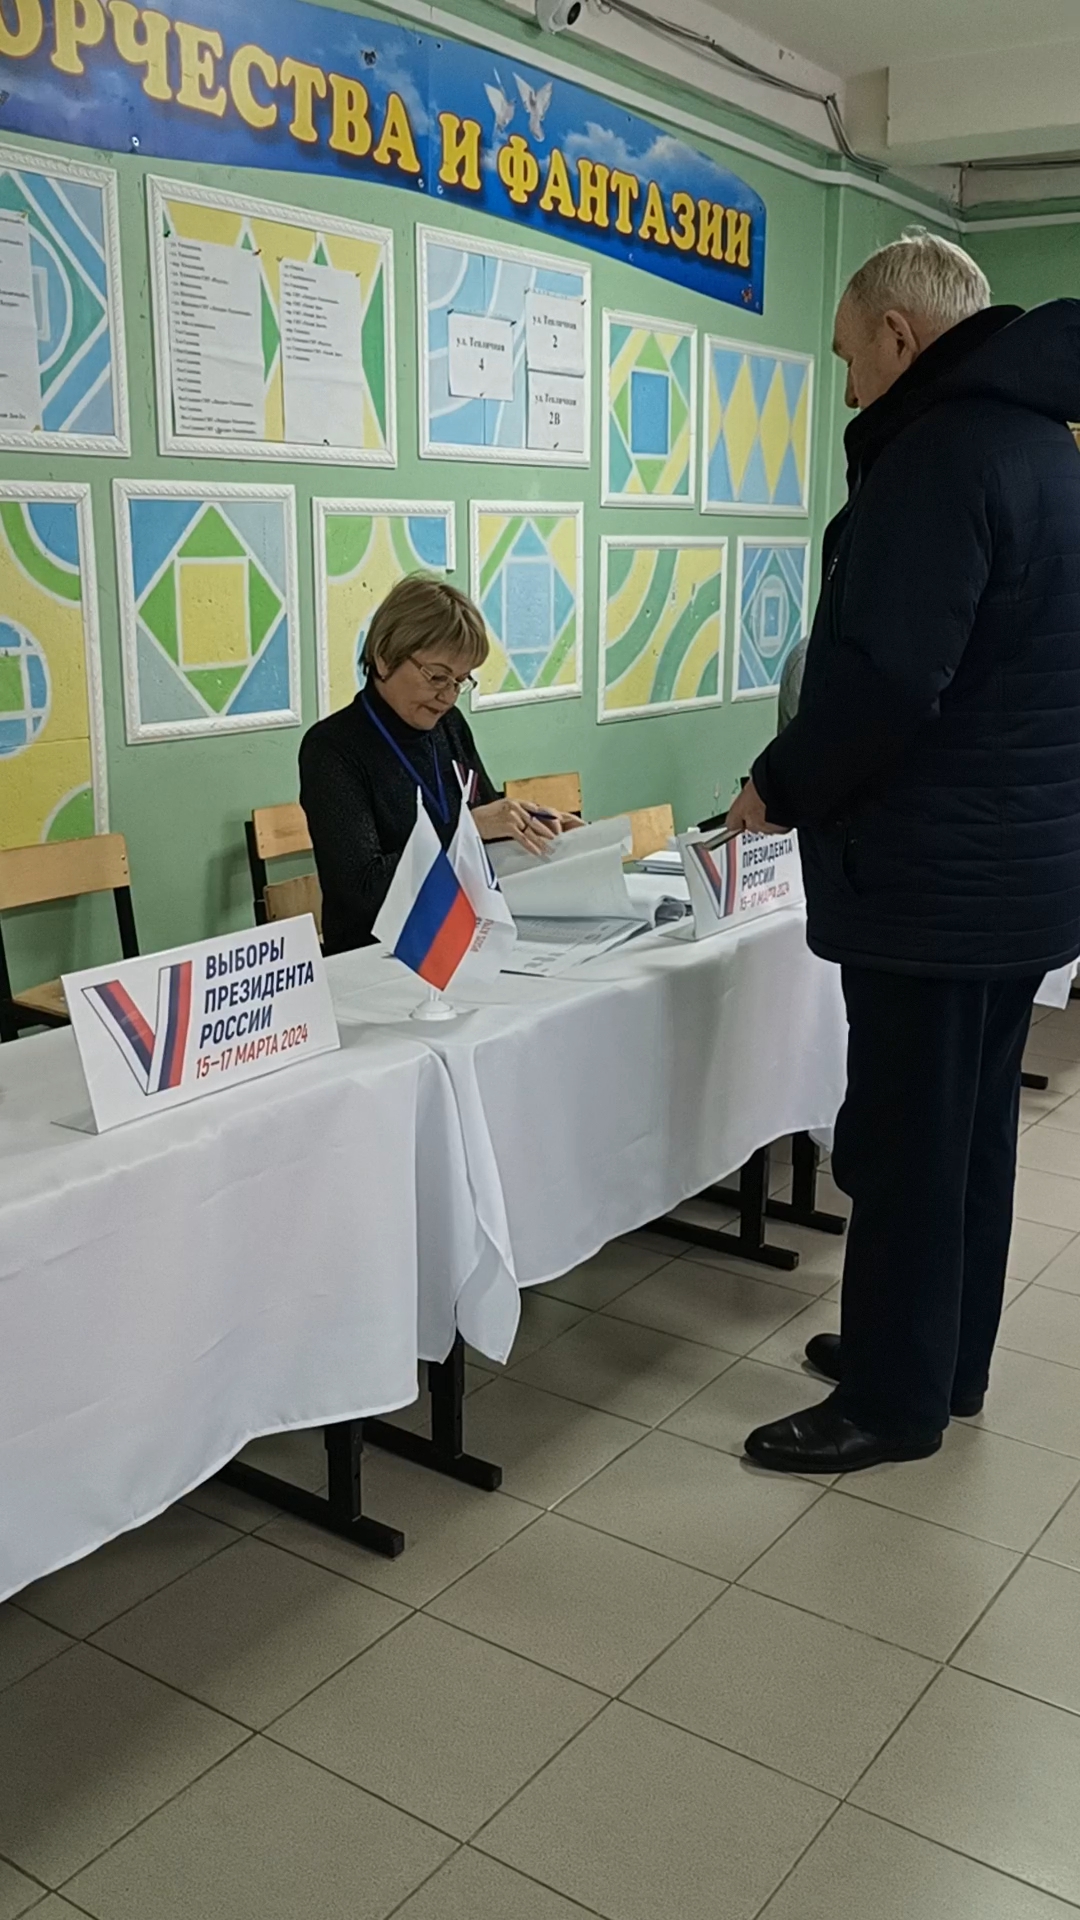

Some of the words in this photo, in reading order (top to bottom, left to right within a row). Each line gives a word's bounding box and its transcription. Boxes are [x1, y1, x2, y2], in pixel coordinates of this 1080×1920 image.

[438, 111, 482, 191] И
[496, 133, 752, 269] ФАНТАЗИИ
[552, 334, 559, 349] 2
[478, 357, 485, 371] 4
[548, 411, 562, 426] 2В
[742, 838, 793, 869] ПРЕЗИДЕНТА
[742, 865, 776, 891] РОССИИ
[205, 936, 285, 980] ВЫБОРЫ
[204, 960, 314, 1014] ПРЕЗИДЕНТА
[199, 1003, 273, 1049] РОССИИ
[234, 1033, 279, 1066] МАРТА
[280, 1022, 309, 1052] 2024
